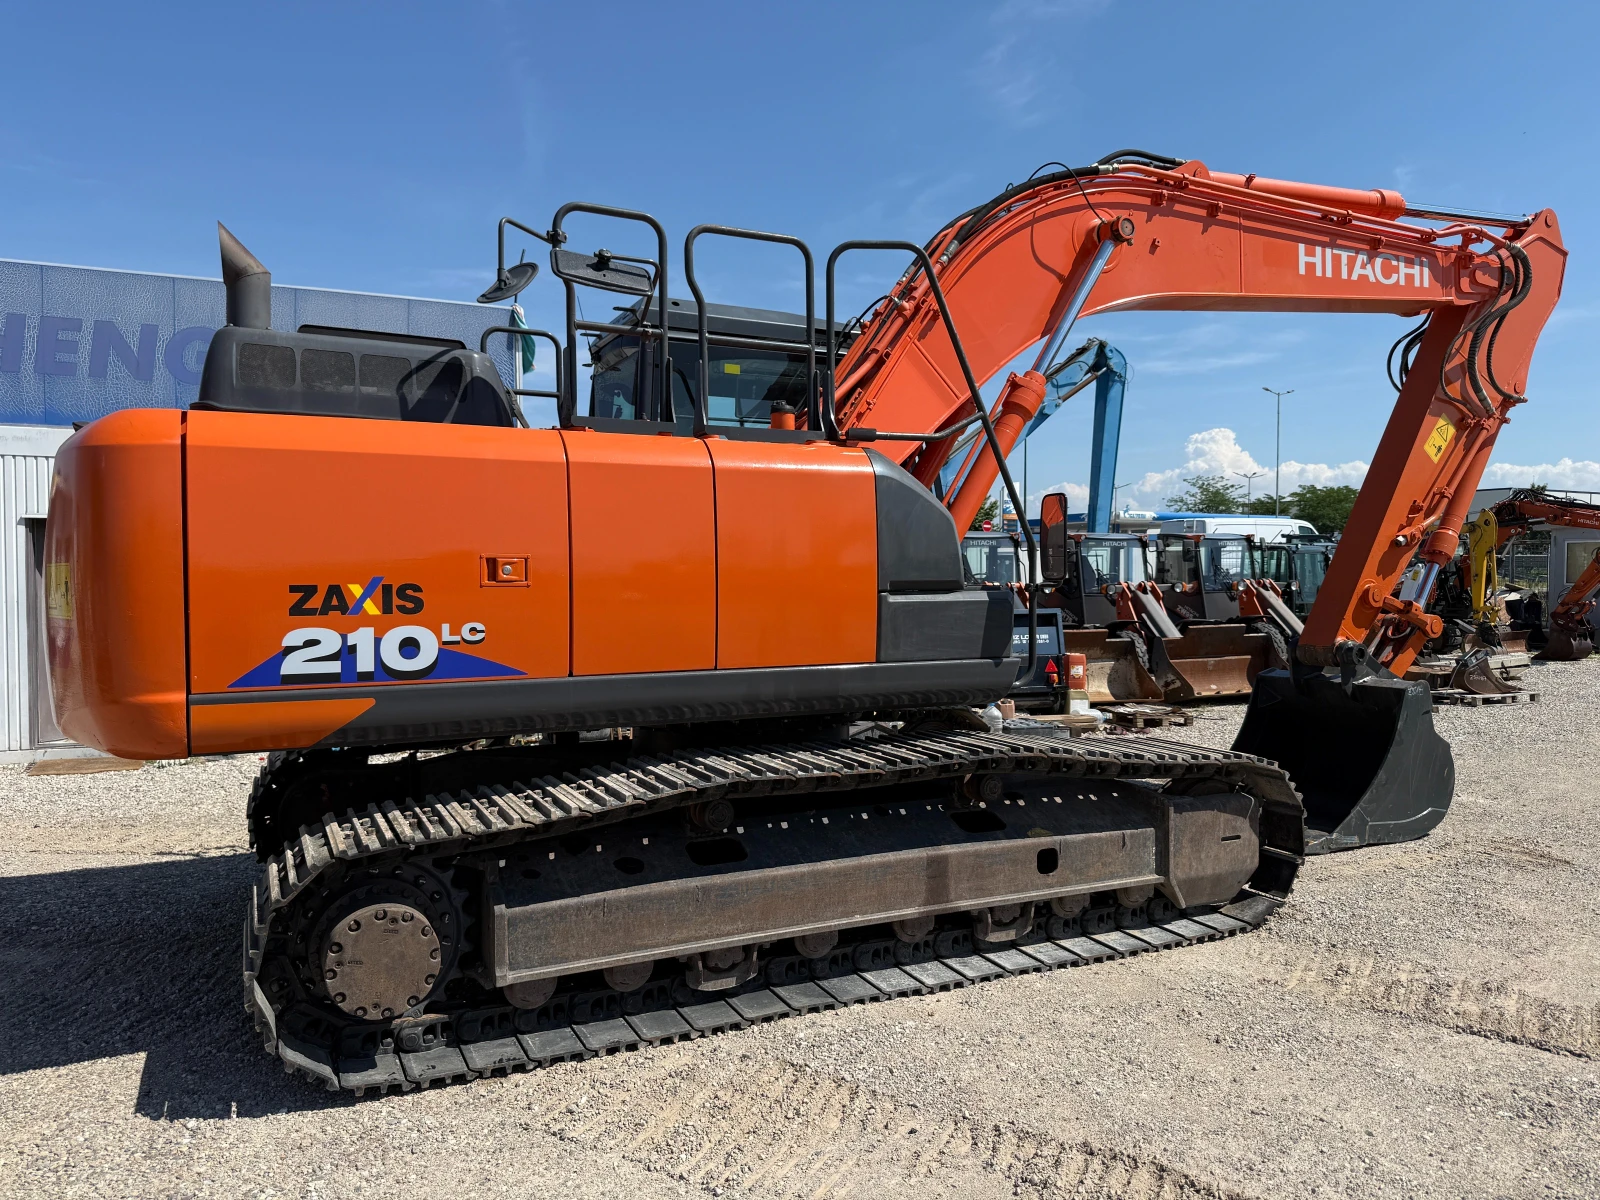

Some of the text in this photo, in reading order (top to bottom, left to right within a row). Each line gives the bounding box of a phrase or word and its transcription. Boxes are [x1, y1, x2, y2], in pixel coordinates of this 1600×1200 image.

[1298, 243, 1429, 288] HITACHI
[288, 576, 425, 616] ZAXIS
[280, 621, 486, 684] 210 LC
